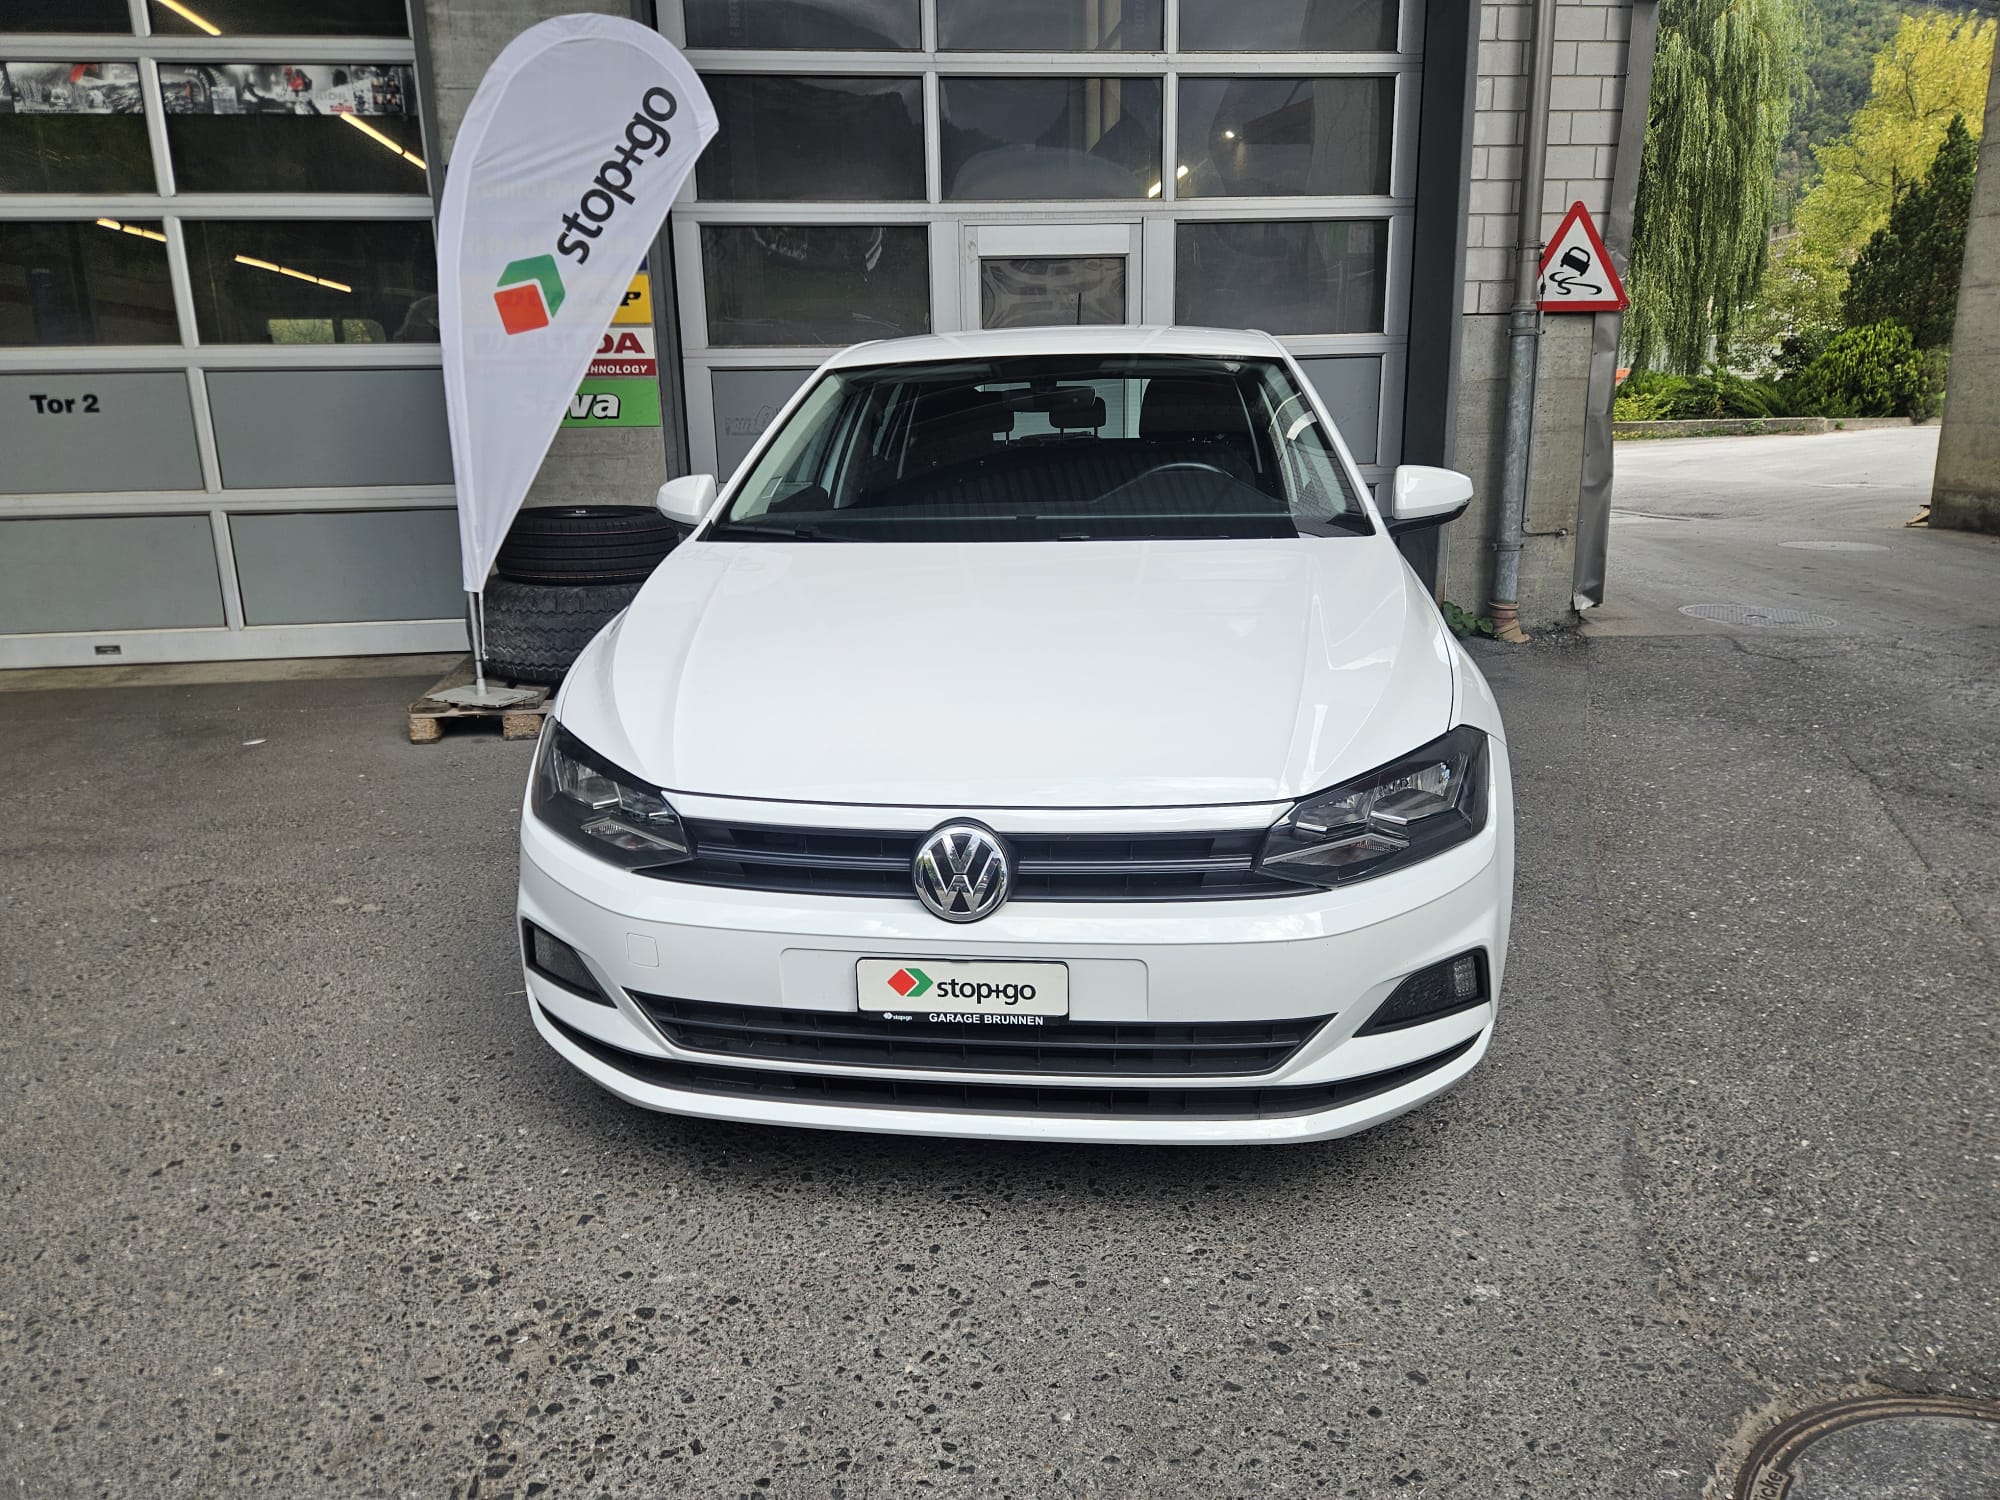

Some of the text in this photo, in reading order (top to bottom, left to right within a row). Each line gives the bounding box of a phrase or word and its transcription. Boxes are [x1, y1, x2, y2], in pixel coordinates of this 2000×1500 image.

[557, 86, 677, 265] stop+go
[29, 394, 100, 414] Tor 2
[937, 978, 1037, 1006] stop+go
[928, 1012, 1044, 1026] GARAGE BRUNNEN
